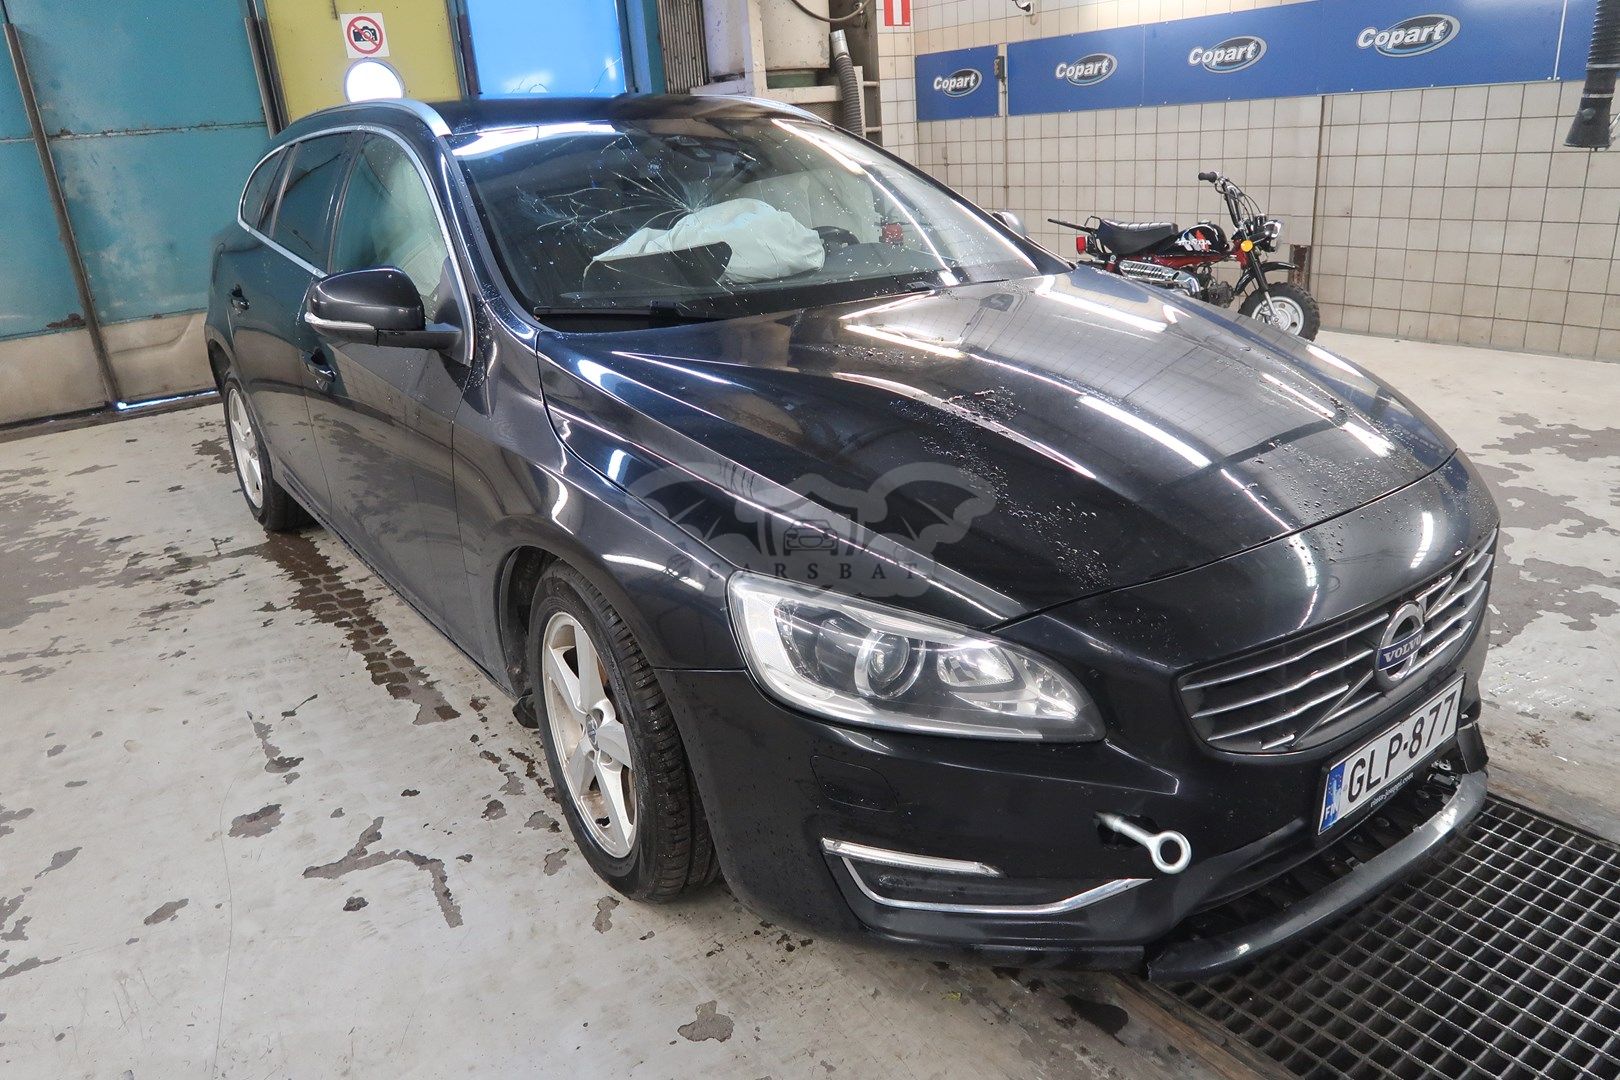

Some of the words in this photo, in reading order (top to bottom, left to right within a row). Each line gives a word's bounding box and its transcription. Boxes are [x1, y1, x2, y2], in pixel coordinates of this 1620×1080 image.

[1356, 19, 1448, 50] Copart
[1188, 41, 1259, 67] Copart
[933, 73, 976, 92] Copart
[1055, 60, 1109, 82] Copart
[1383, 634, 1422, 663] VOLVO
[1348, 690, 1459, 803] GLP-877
